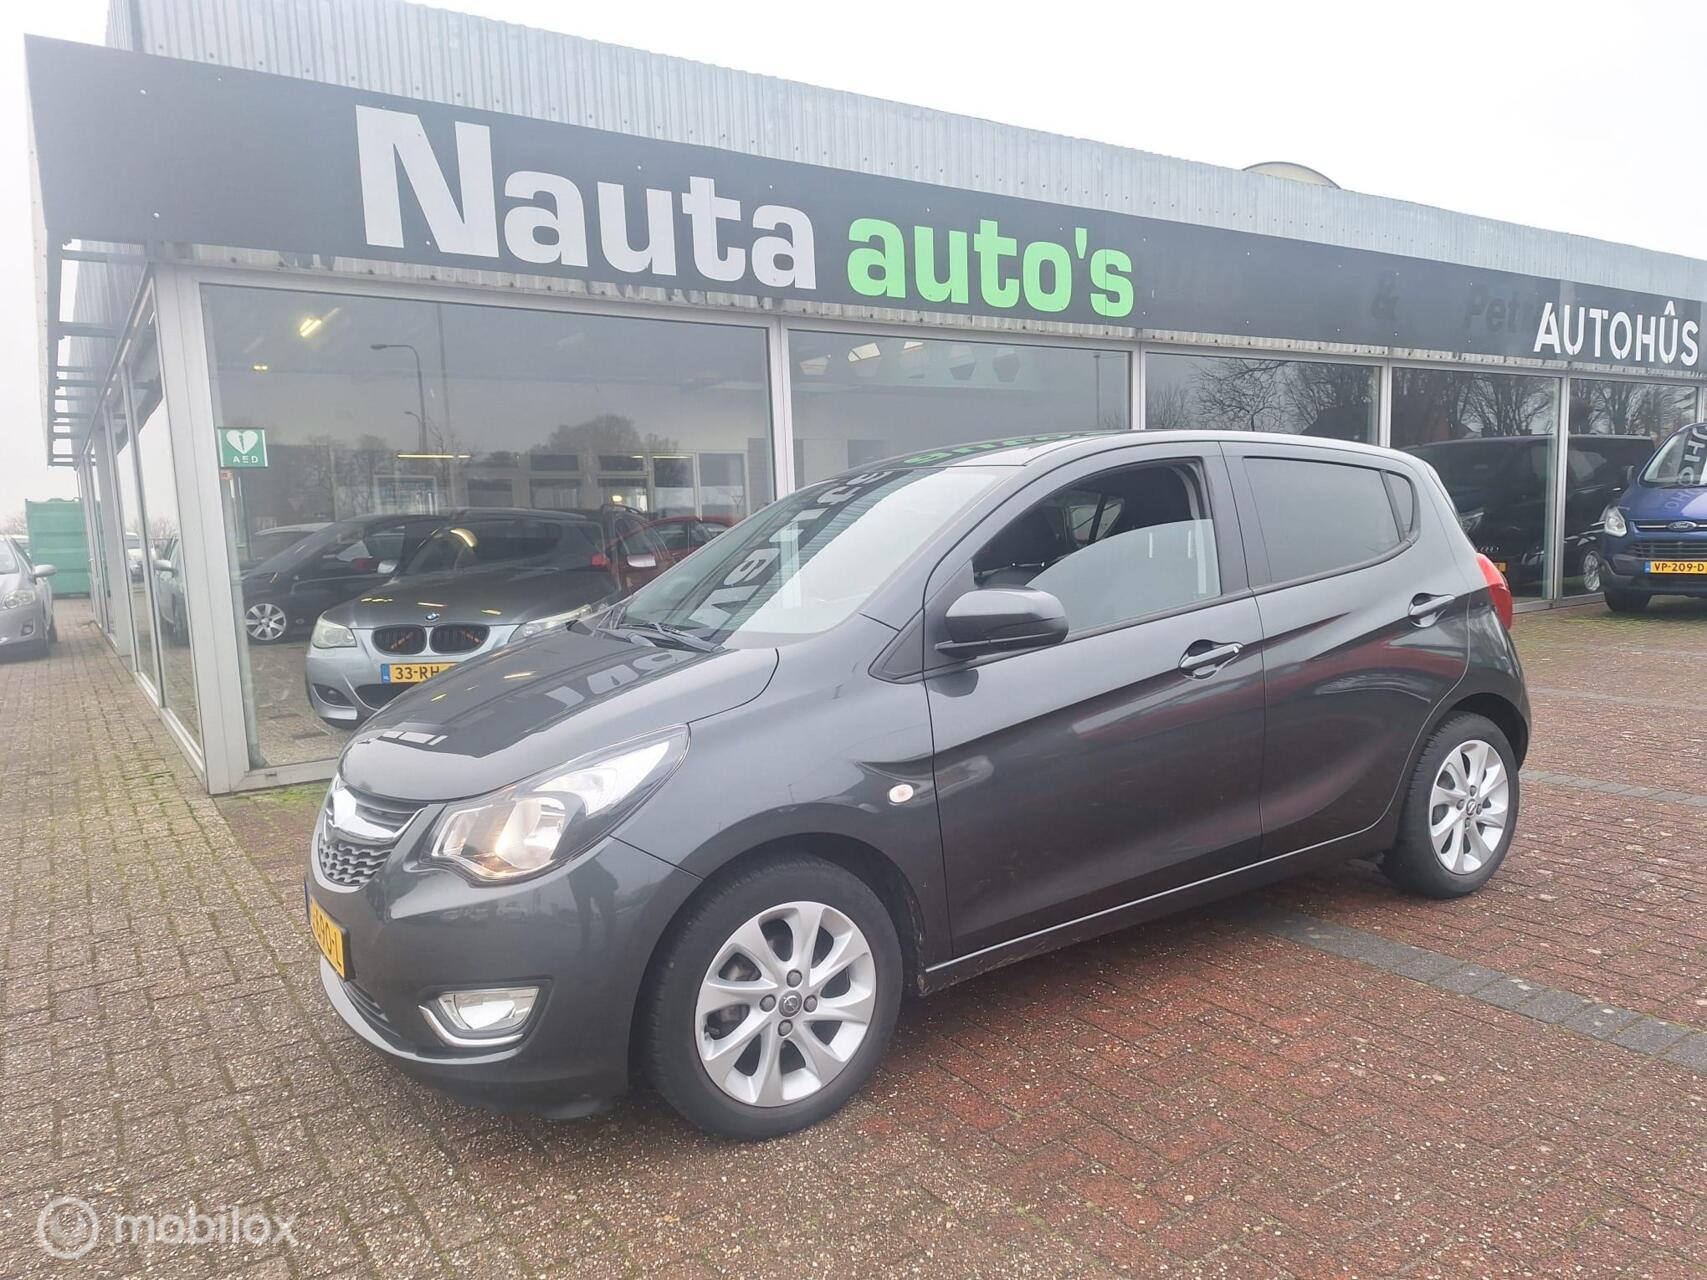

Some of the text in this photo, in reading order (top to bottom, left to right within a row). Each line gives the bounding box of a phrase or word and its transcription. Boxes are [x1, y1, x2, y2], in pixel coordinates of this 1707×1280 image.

[356, 104, 1134, 318] Nauta auto's
[1533, 300, 1699, 367] AUTOHÛS
[232, 455, 259, 464] AED
